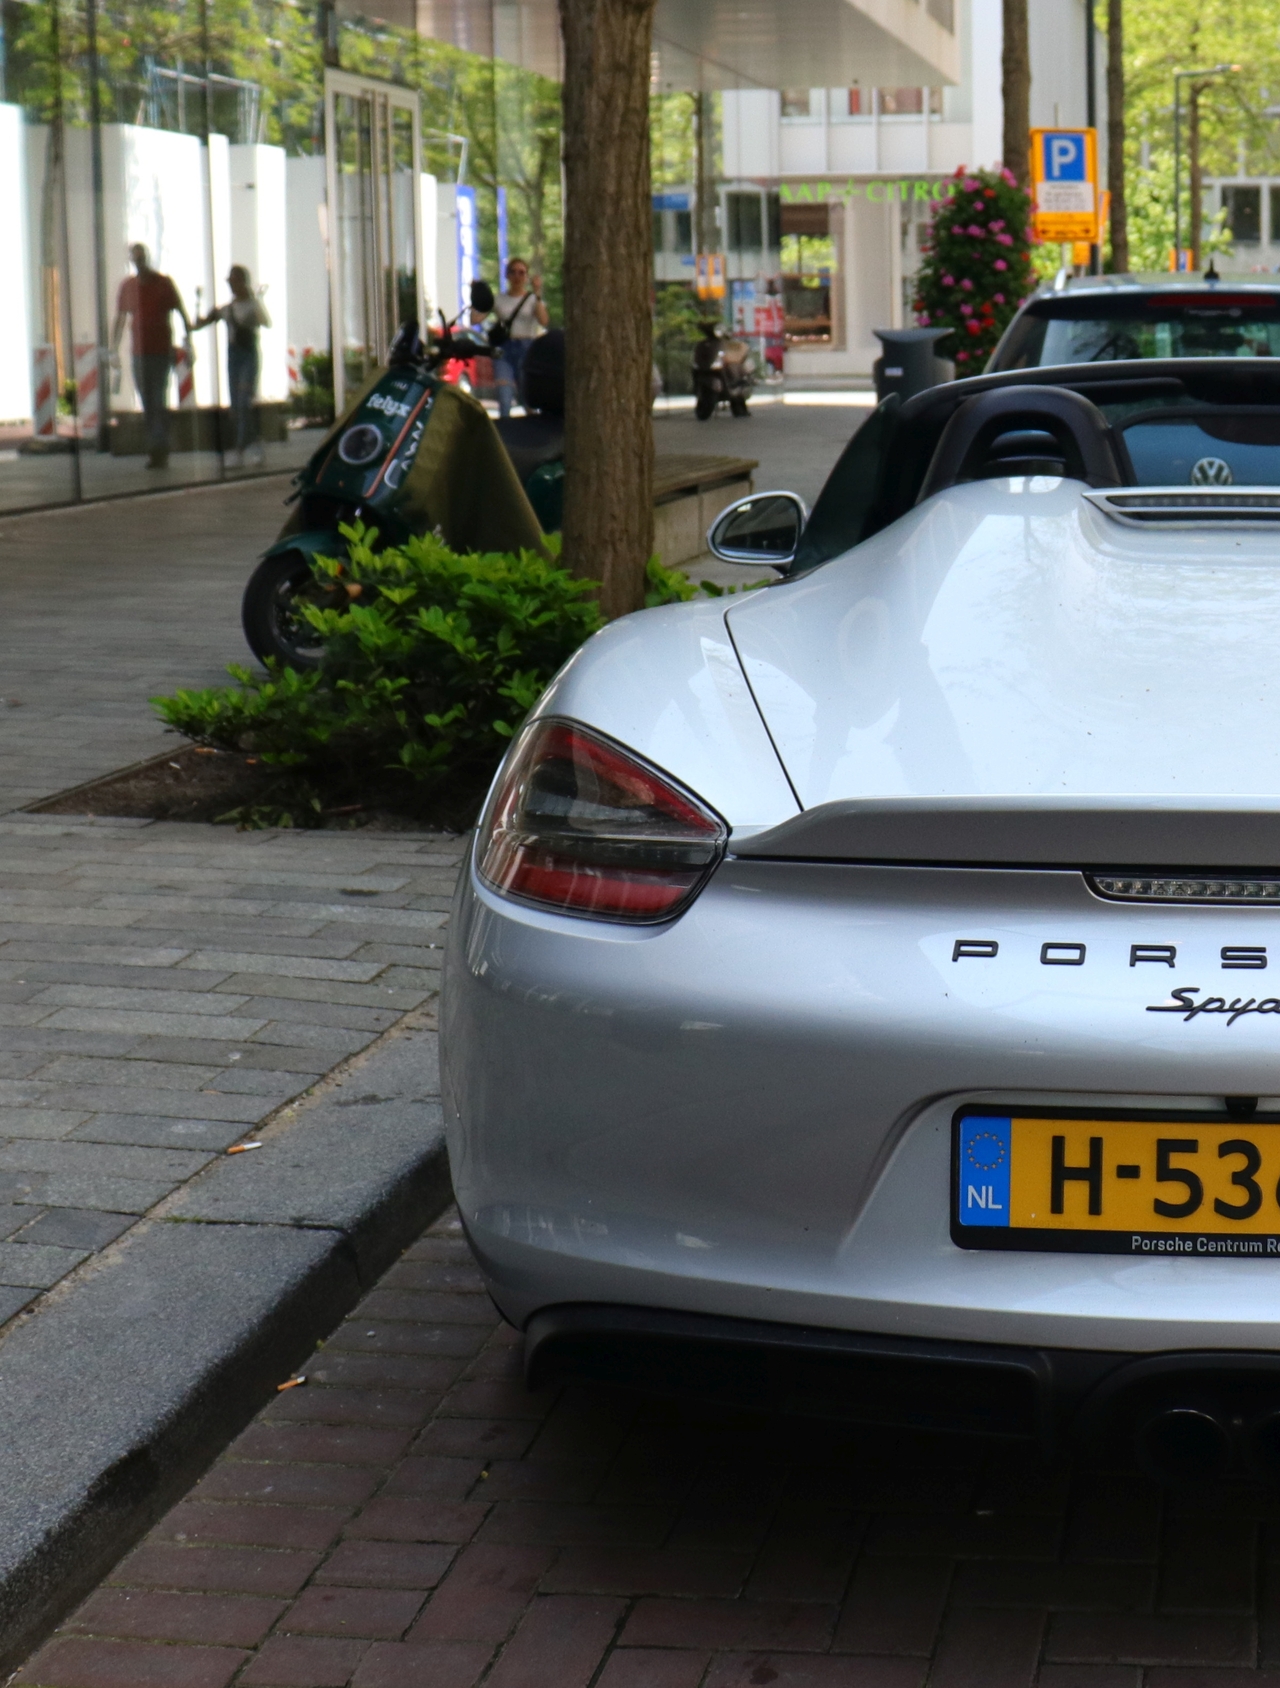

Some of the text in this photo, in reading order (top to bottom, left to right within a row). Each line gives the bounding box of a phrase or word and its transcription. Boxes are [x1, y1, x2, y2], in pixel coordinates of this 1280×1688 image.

[1051, 138, 1077, 177] P
[967, 1185, 1002, 1209] NL
[1131, 1235, 1193, 1251] Porsche
[1196, 1237, 1263, 1253] Centrum
